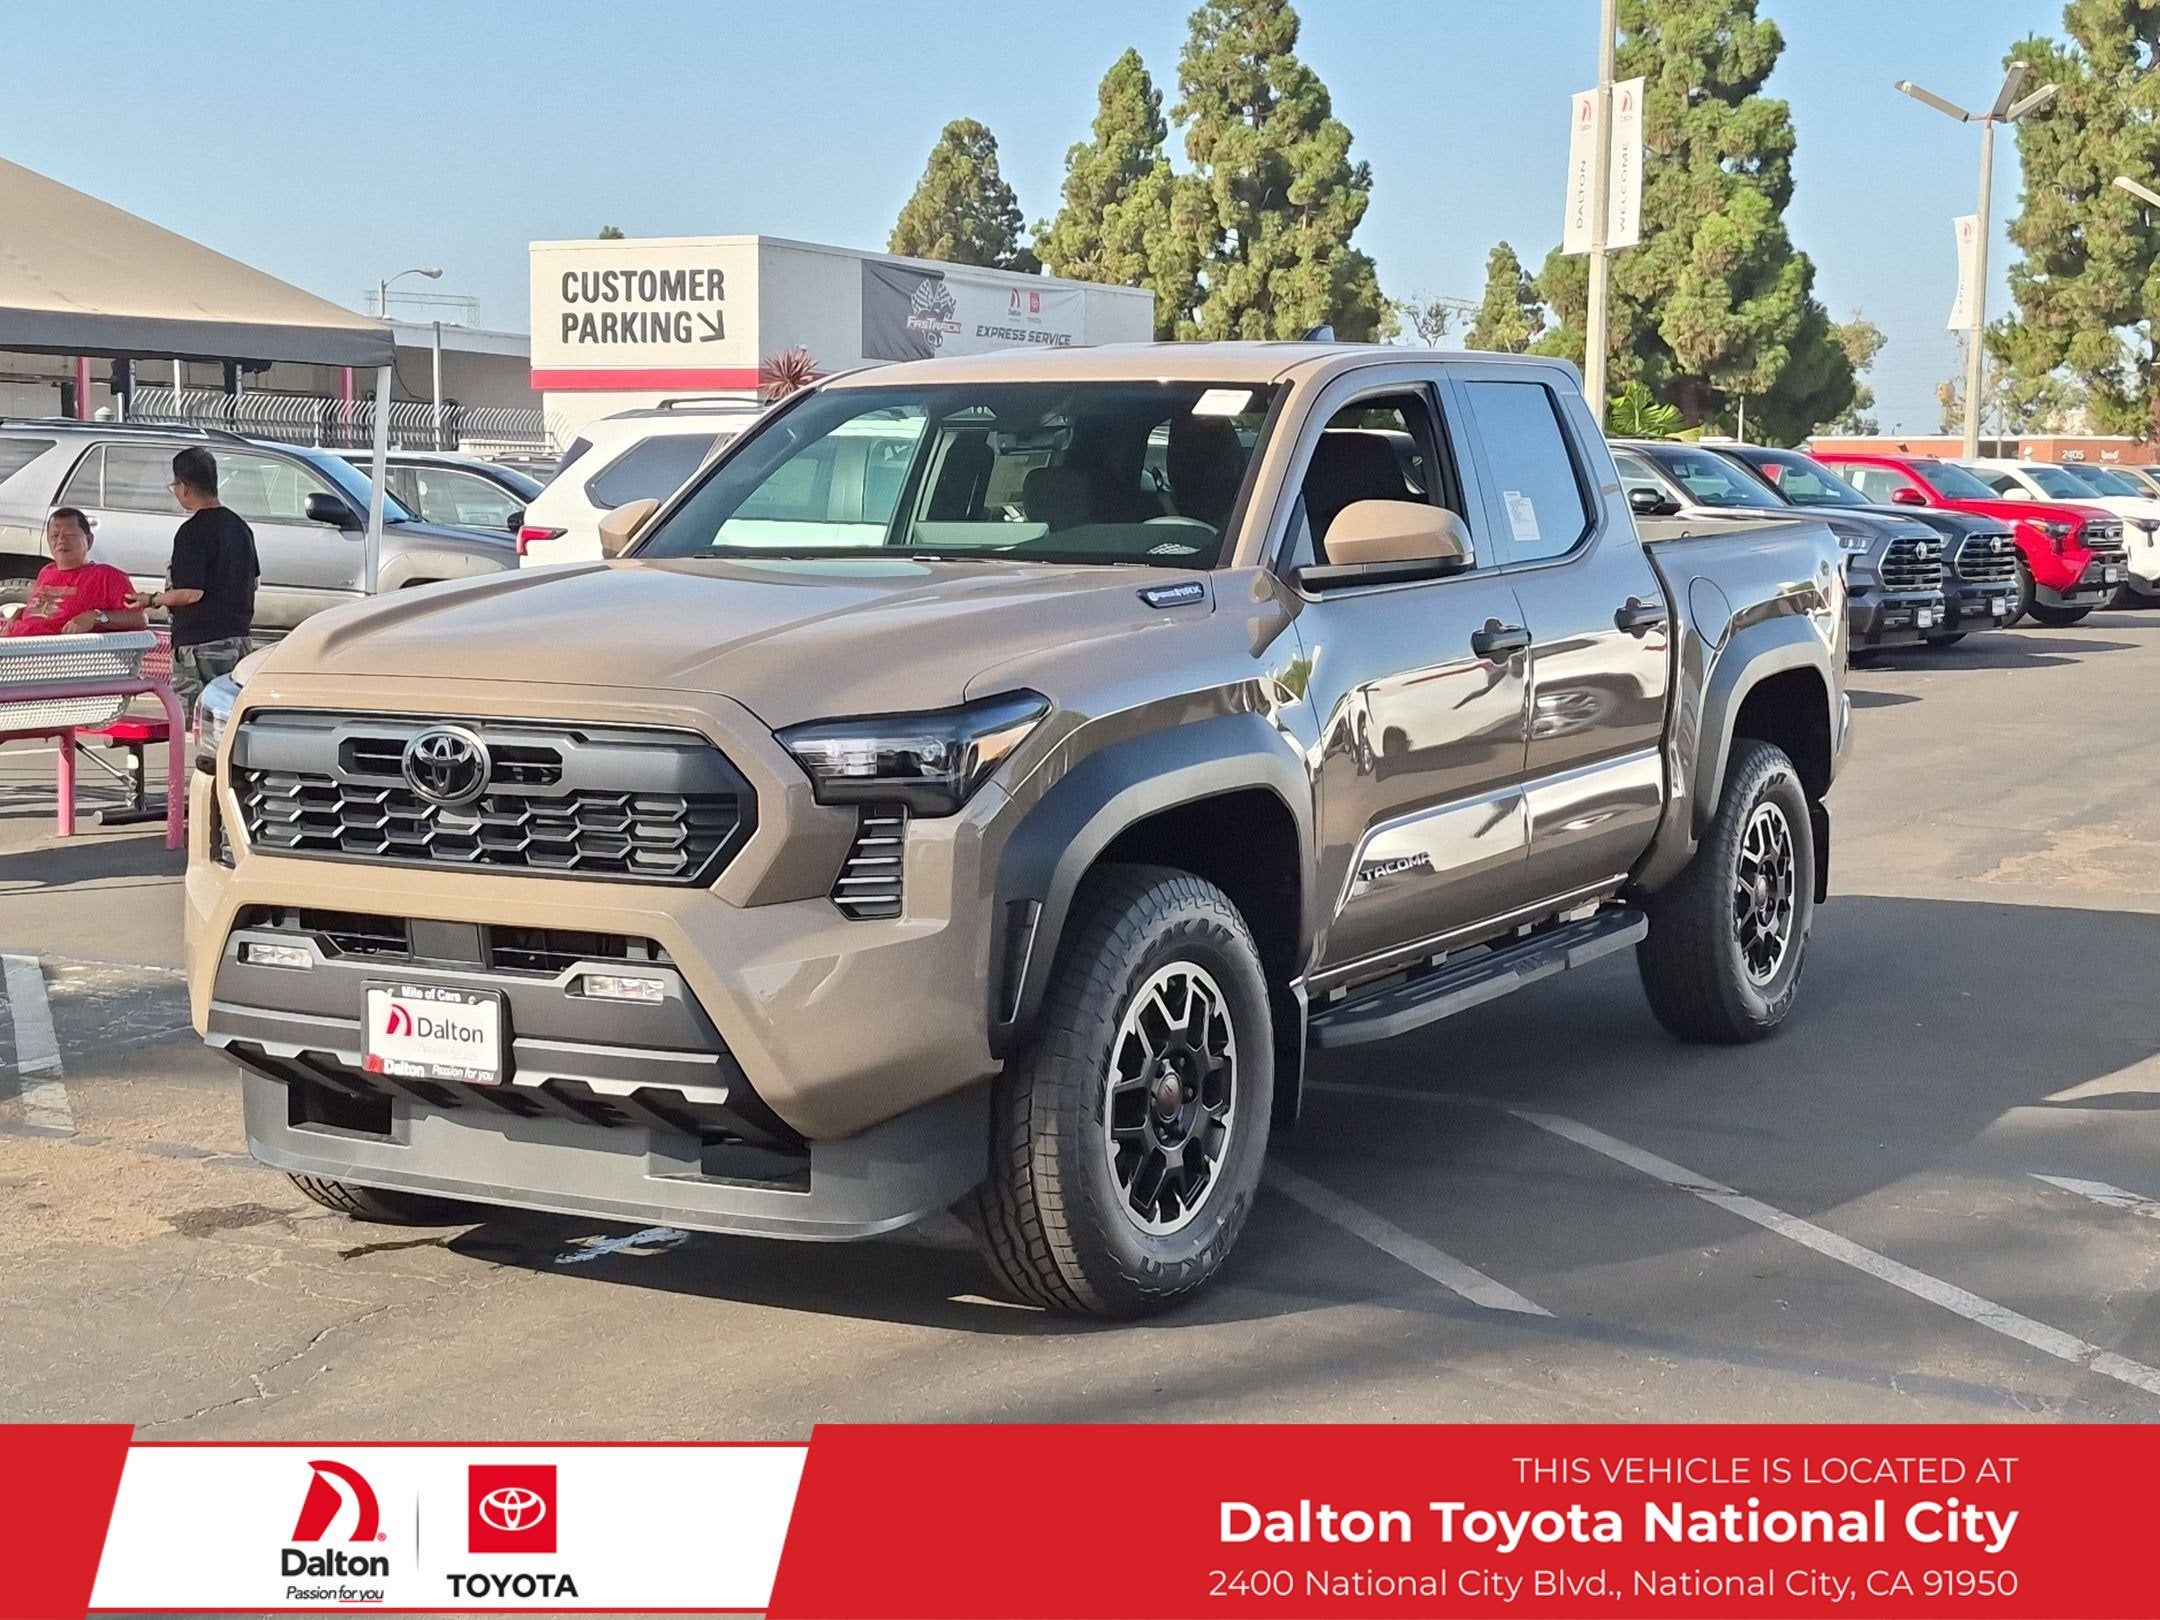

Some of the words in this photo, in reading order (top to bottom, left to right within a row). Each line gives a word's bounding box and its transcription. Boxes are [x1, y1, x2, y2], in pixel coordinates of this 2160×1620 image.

[1577, 160, 1586, 228] DALTON
[562, 269, 726, 303] CUSTOMER
[562, 311, 693, 343] PARKING
[976, 325, 1026, 342] EXPRESS
[1027, 330, 1072, 346] SERVICE
[1361, 851, 1432, 880] TACOMA
[401, 985, 423, 999] Mile
[425, 988, 436, 1000] of
[437, 988, 462, 1002] Cars
[417, 1016, 484, 1044] Dalton
[383, 1058, 425, 1078] Dalton
[432, 1064, 464, 1078] Passion
[464, 1067, 478, 1078] for
[478, 1071, 495, 1082] you
